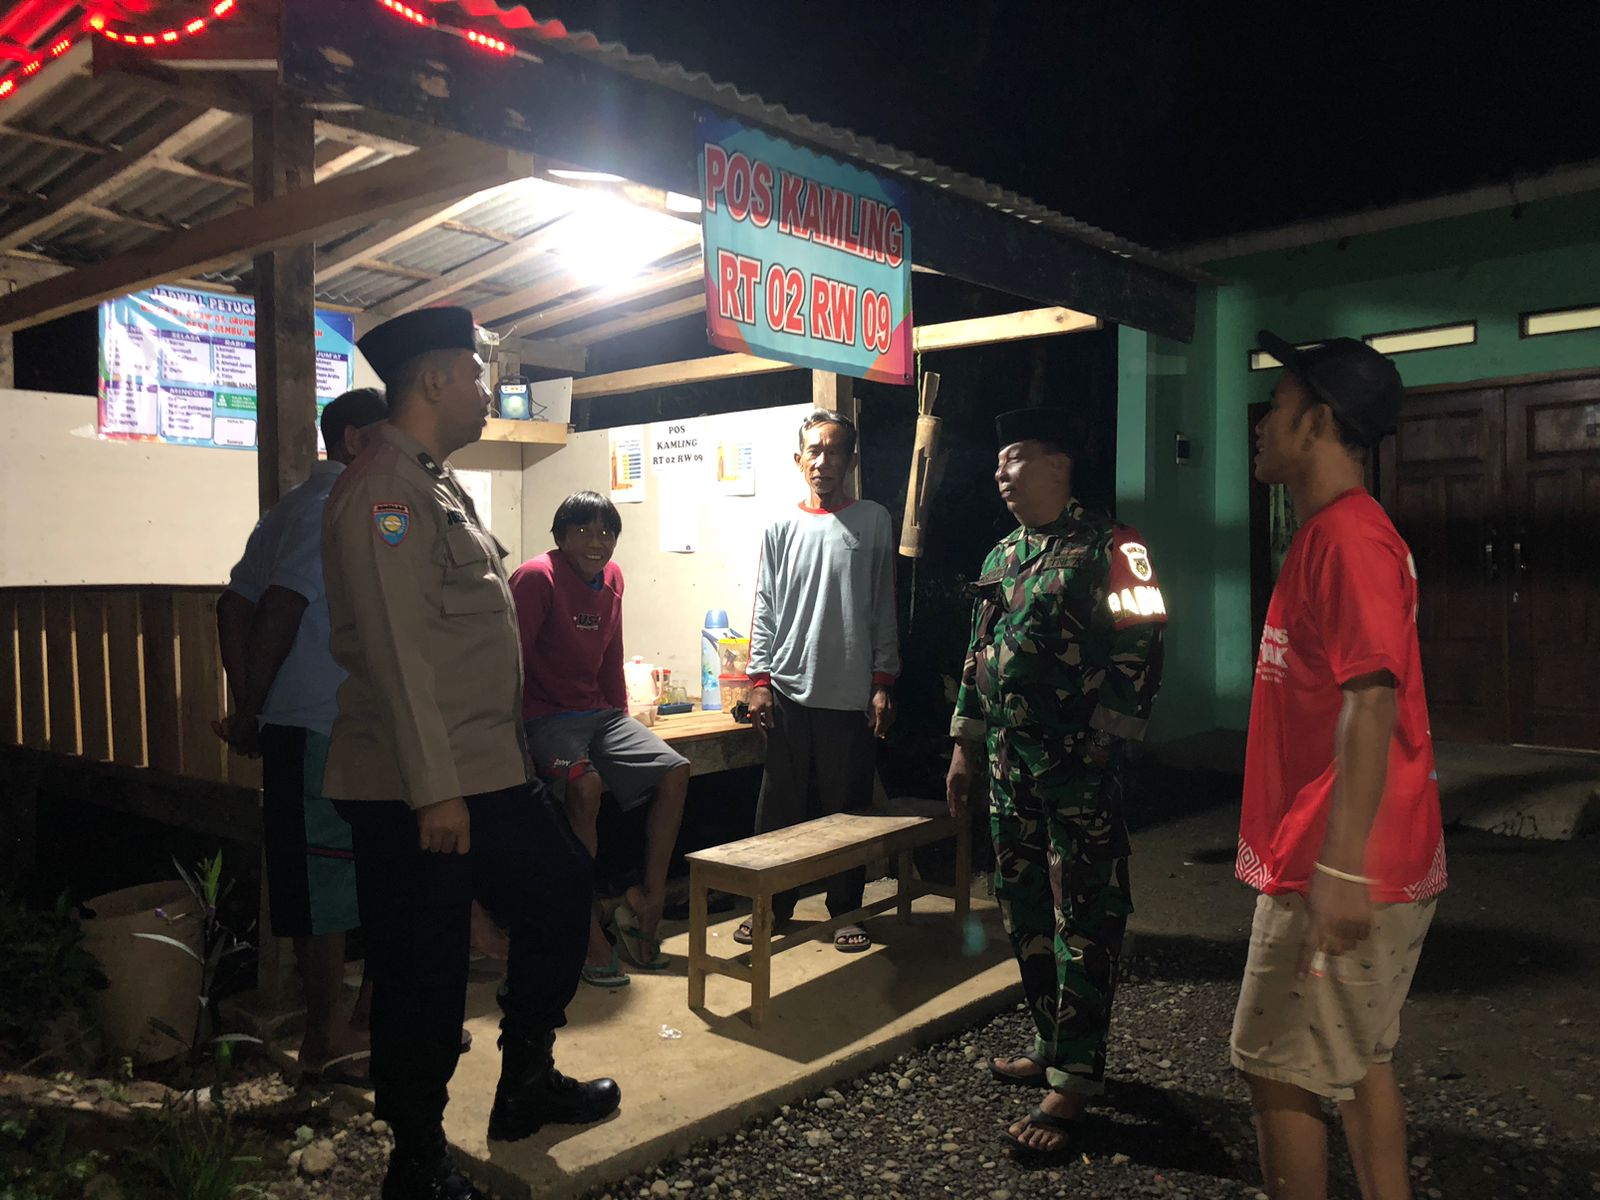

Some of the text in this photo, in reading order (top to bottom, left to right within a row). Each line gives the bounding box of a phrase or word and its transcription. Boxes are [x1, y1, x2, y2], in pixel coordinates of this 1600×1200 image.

[704, 143, 904, 268] POS KAMLING
[717, 247, 892, 354] RT 02 RW 09
[668, 425, 686, 435] POS
[656, 439, 698, 450] KAMLING
[652, 456, 664, 465] RT
[677, 453, 692, 463] RW
[694, 454, 704, 462] 09
